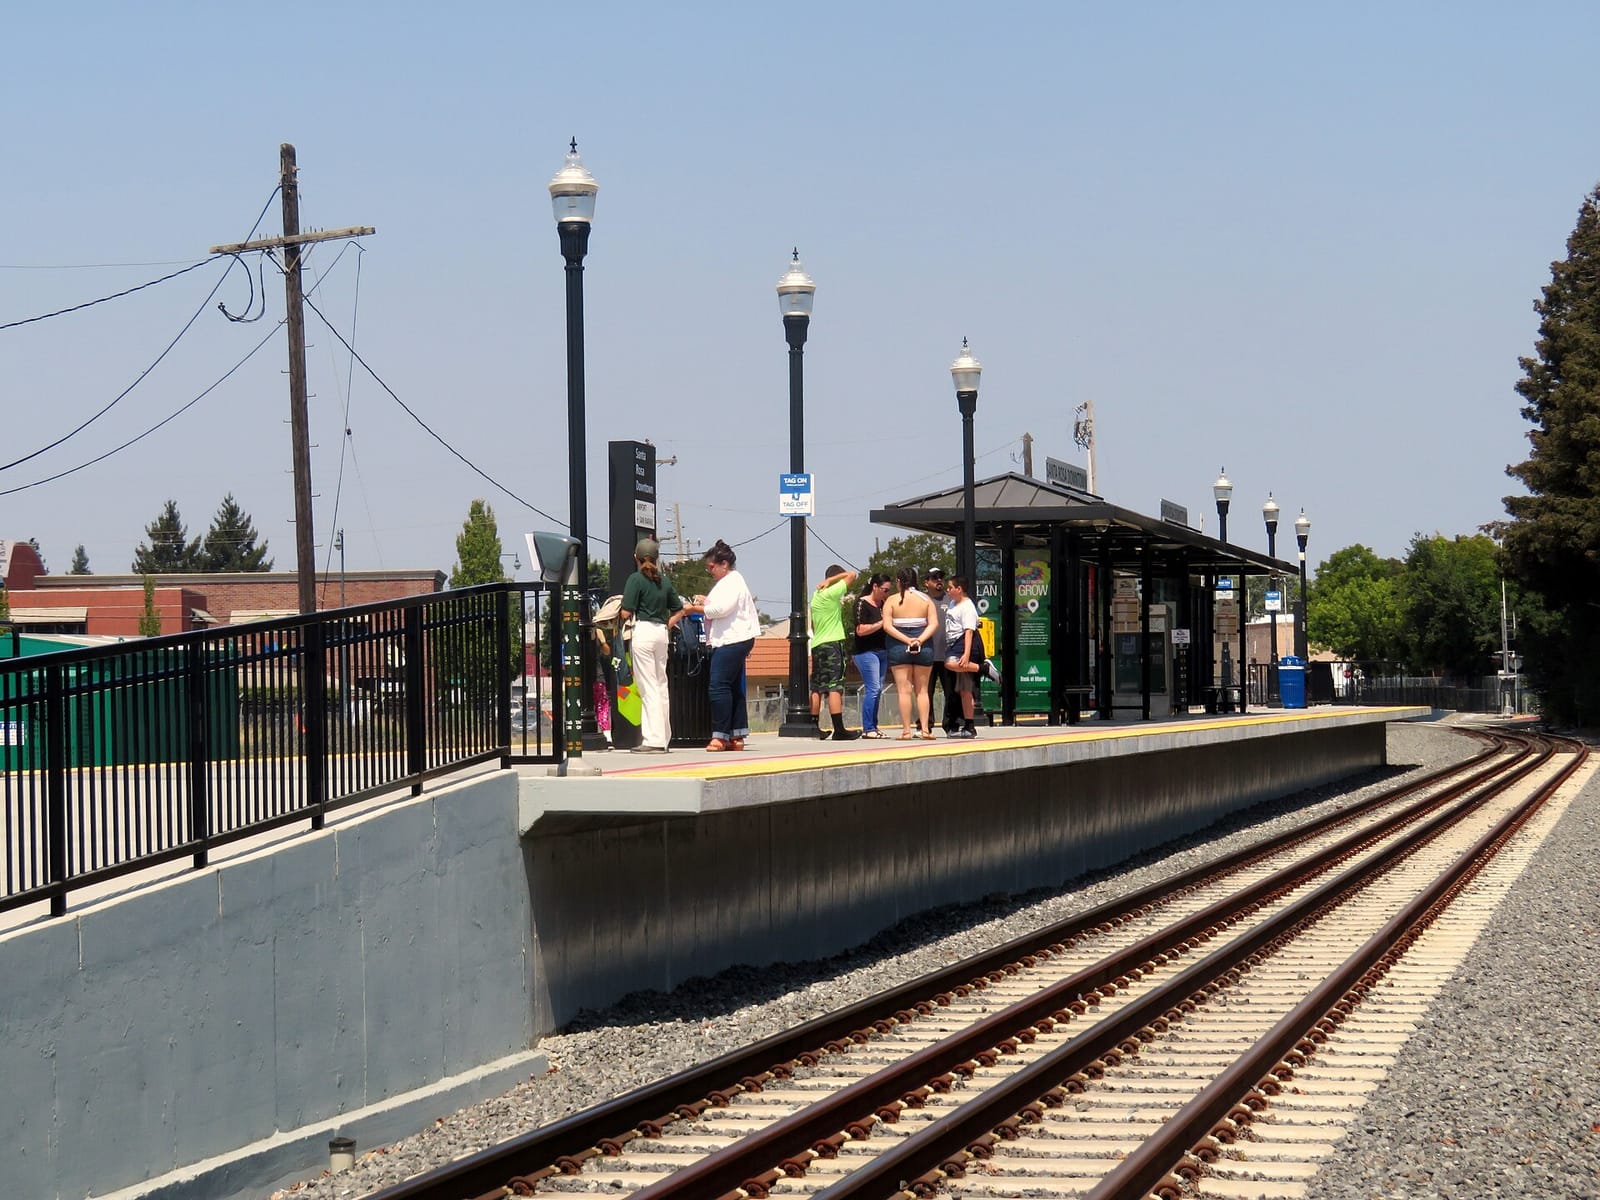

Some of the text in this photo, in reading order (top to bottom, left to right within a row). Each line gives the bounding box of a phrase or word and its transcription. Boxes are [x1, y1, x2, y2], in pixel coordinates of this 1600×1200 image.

[635, 447, 647, 461] Santa
[635, 463, 645, 477] Rosa
[635, 479, 654, 494] Downtown
[976, 585, 998, 597] LAN
[1018, 584, 1049, 596] GROW
